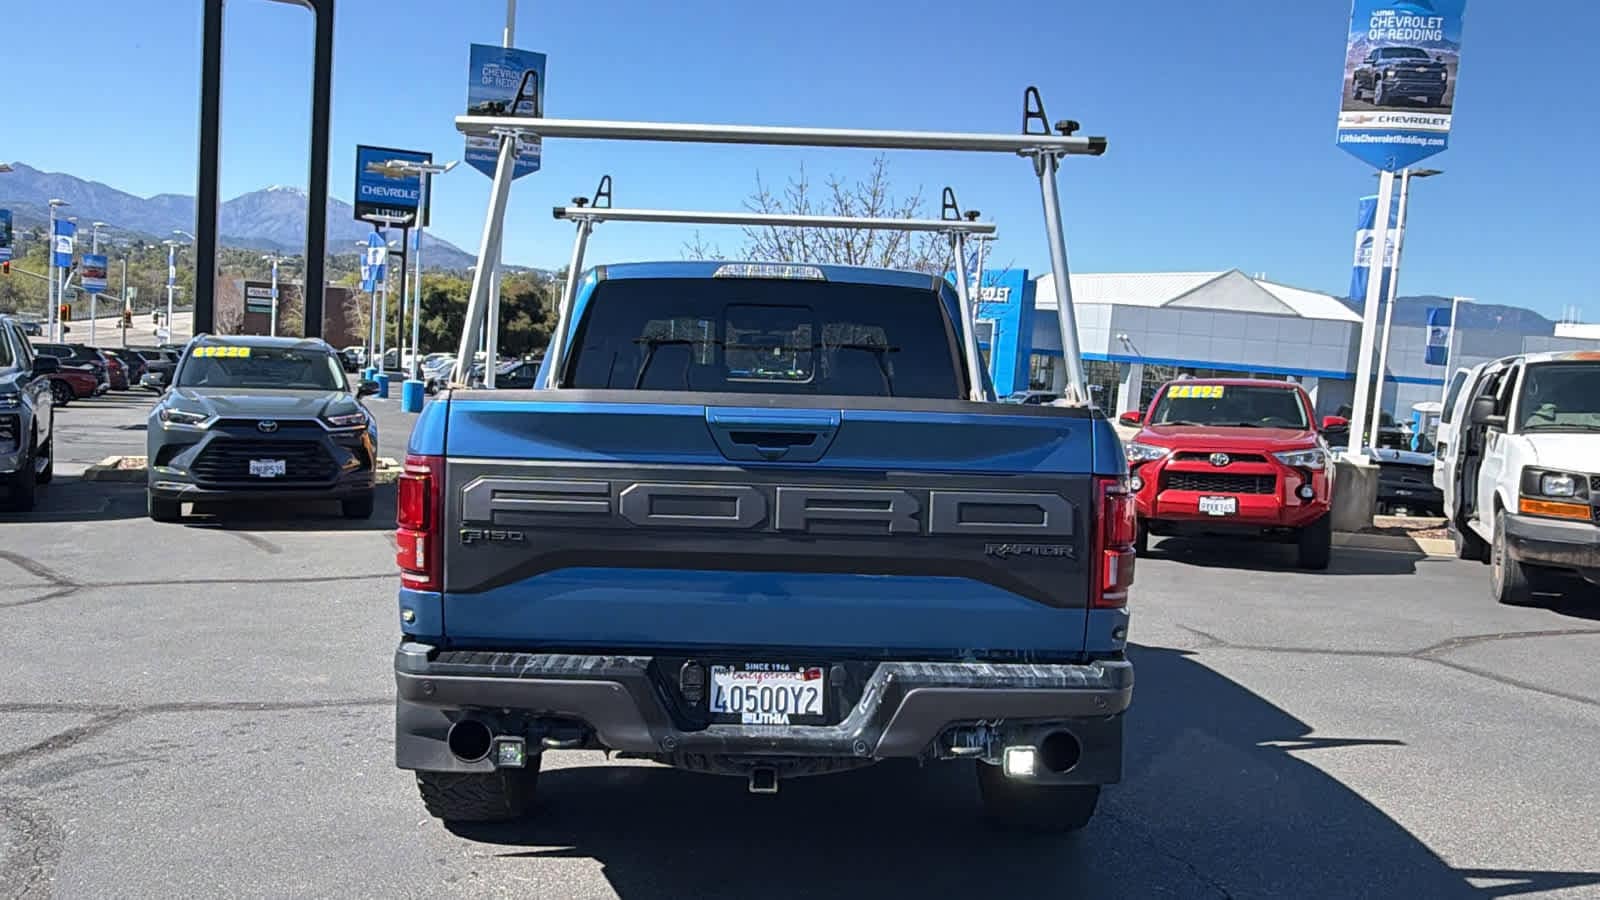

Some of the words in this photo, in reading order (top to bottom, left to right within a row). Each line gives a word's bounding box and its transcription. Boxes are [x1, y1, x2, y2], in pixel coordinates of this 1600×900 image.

[1370, 16, 1444, 29] CHEVROLET
[1368, 28, 1386, 41] OF
[1387, 28, 1443, 41] REDDING
[1378, 115, 1446, 126] CHEVROLET
[1340, 133, 1445, 147] LithiaChevroletRedding.com
[361, 184, 420, 200] CHEVROLE
[460, 476, 1076, 536] FORD
[984, 543, 1076, 559] RAPTOR
[744, 662, 770, 671] SINCE
[714, 686, 818, 713] 40500Y2
[753, 713, 790, 723] LITHIA
